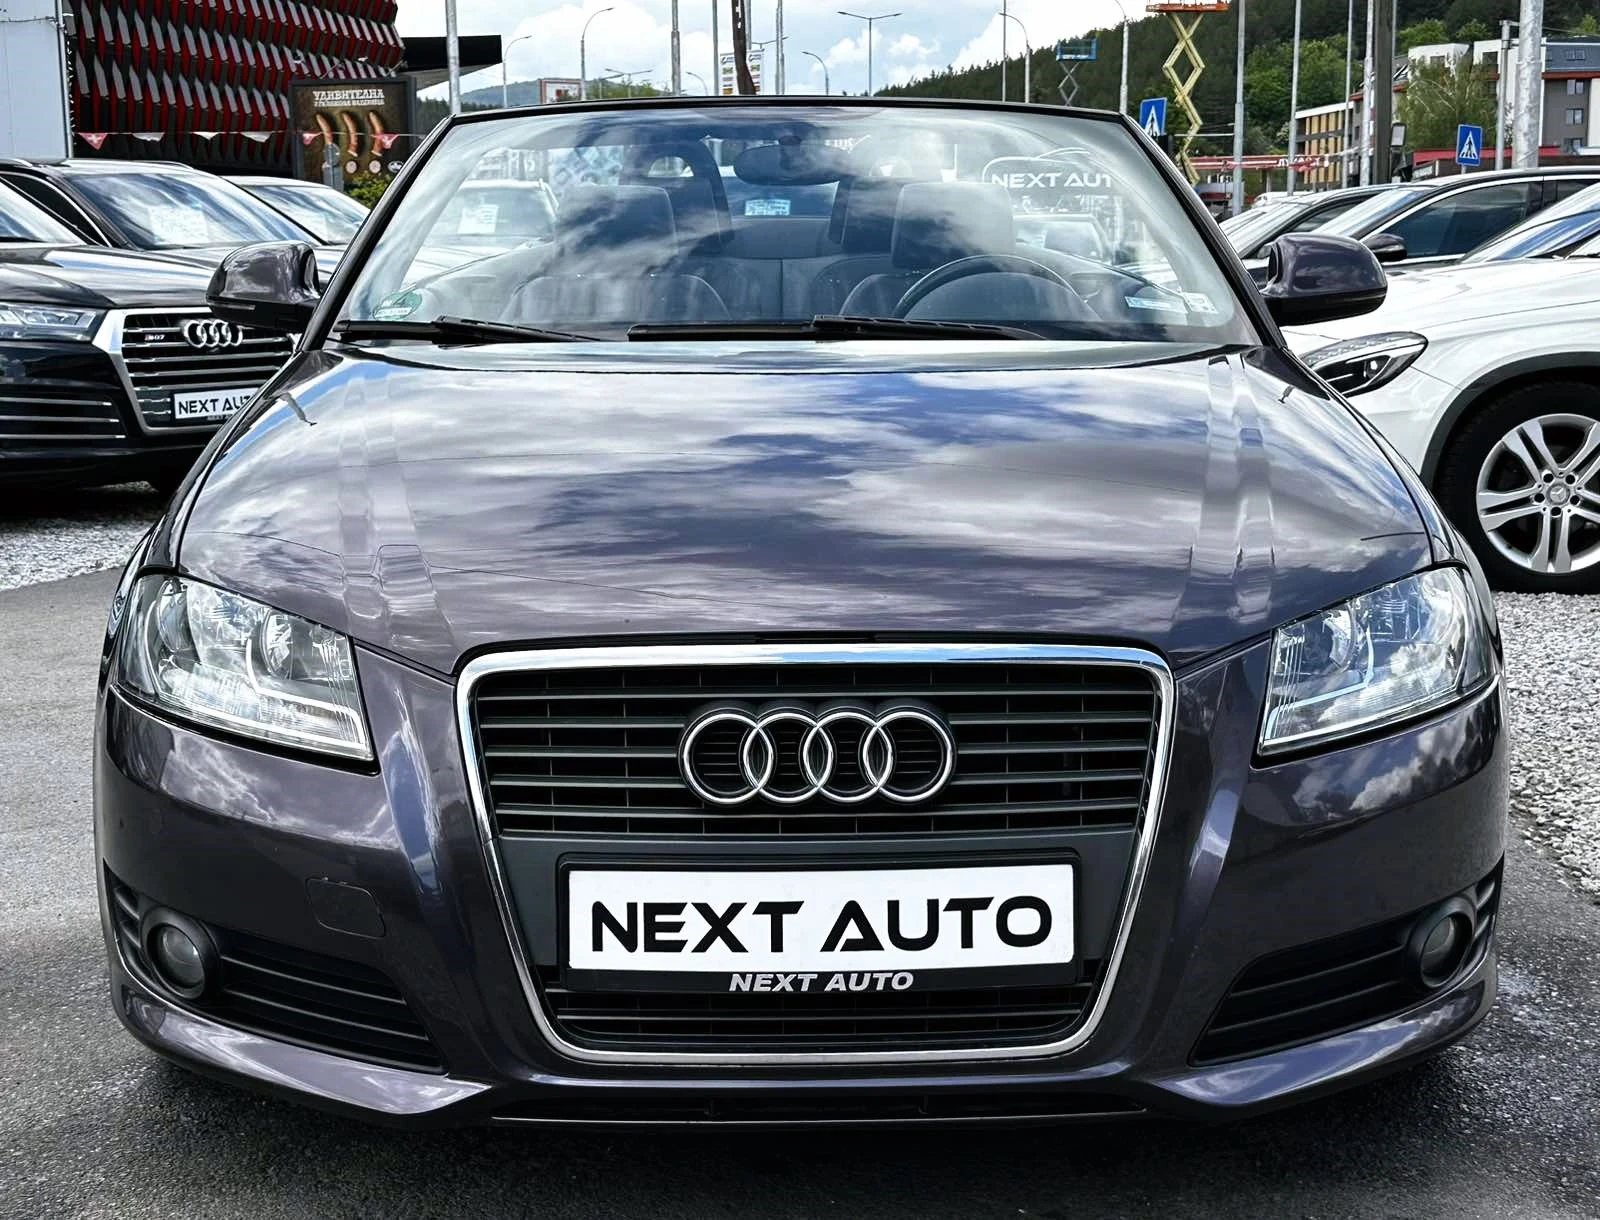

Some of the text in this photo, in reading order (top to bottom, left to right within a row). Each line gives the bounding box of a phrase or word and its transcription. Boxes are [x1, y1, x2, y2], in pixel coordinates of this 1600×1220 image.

[991, 173, 1062, 188] NEXT
[178, 398, 219, 415] NEXT
[592, 895, 1053, 953] NEXT AUTO
[729, 971, 914, 992] NEXT AUTO
